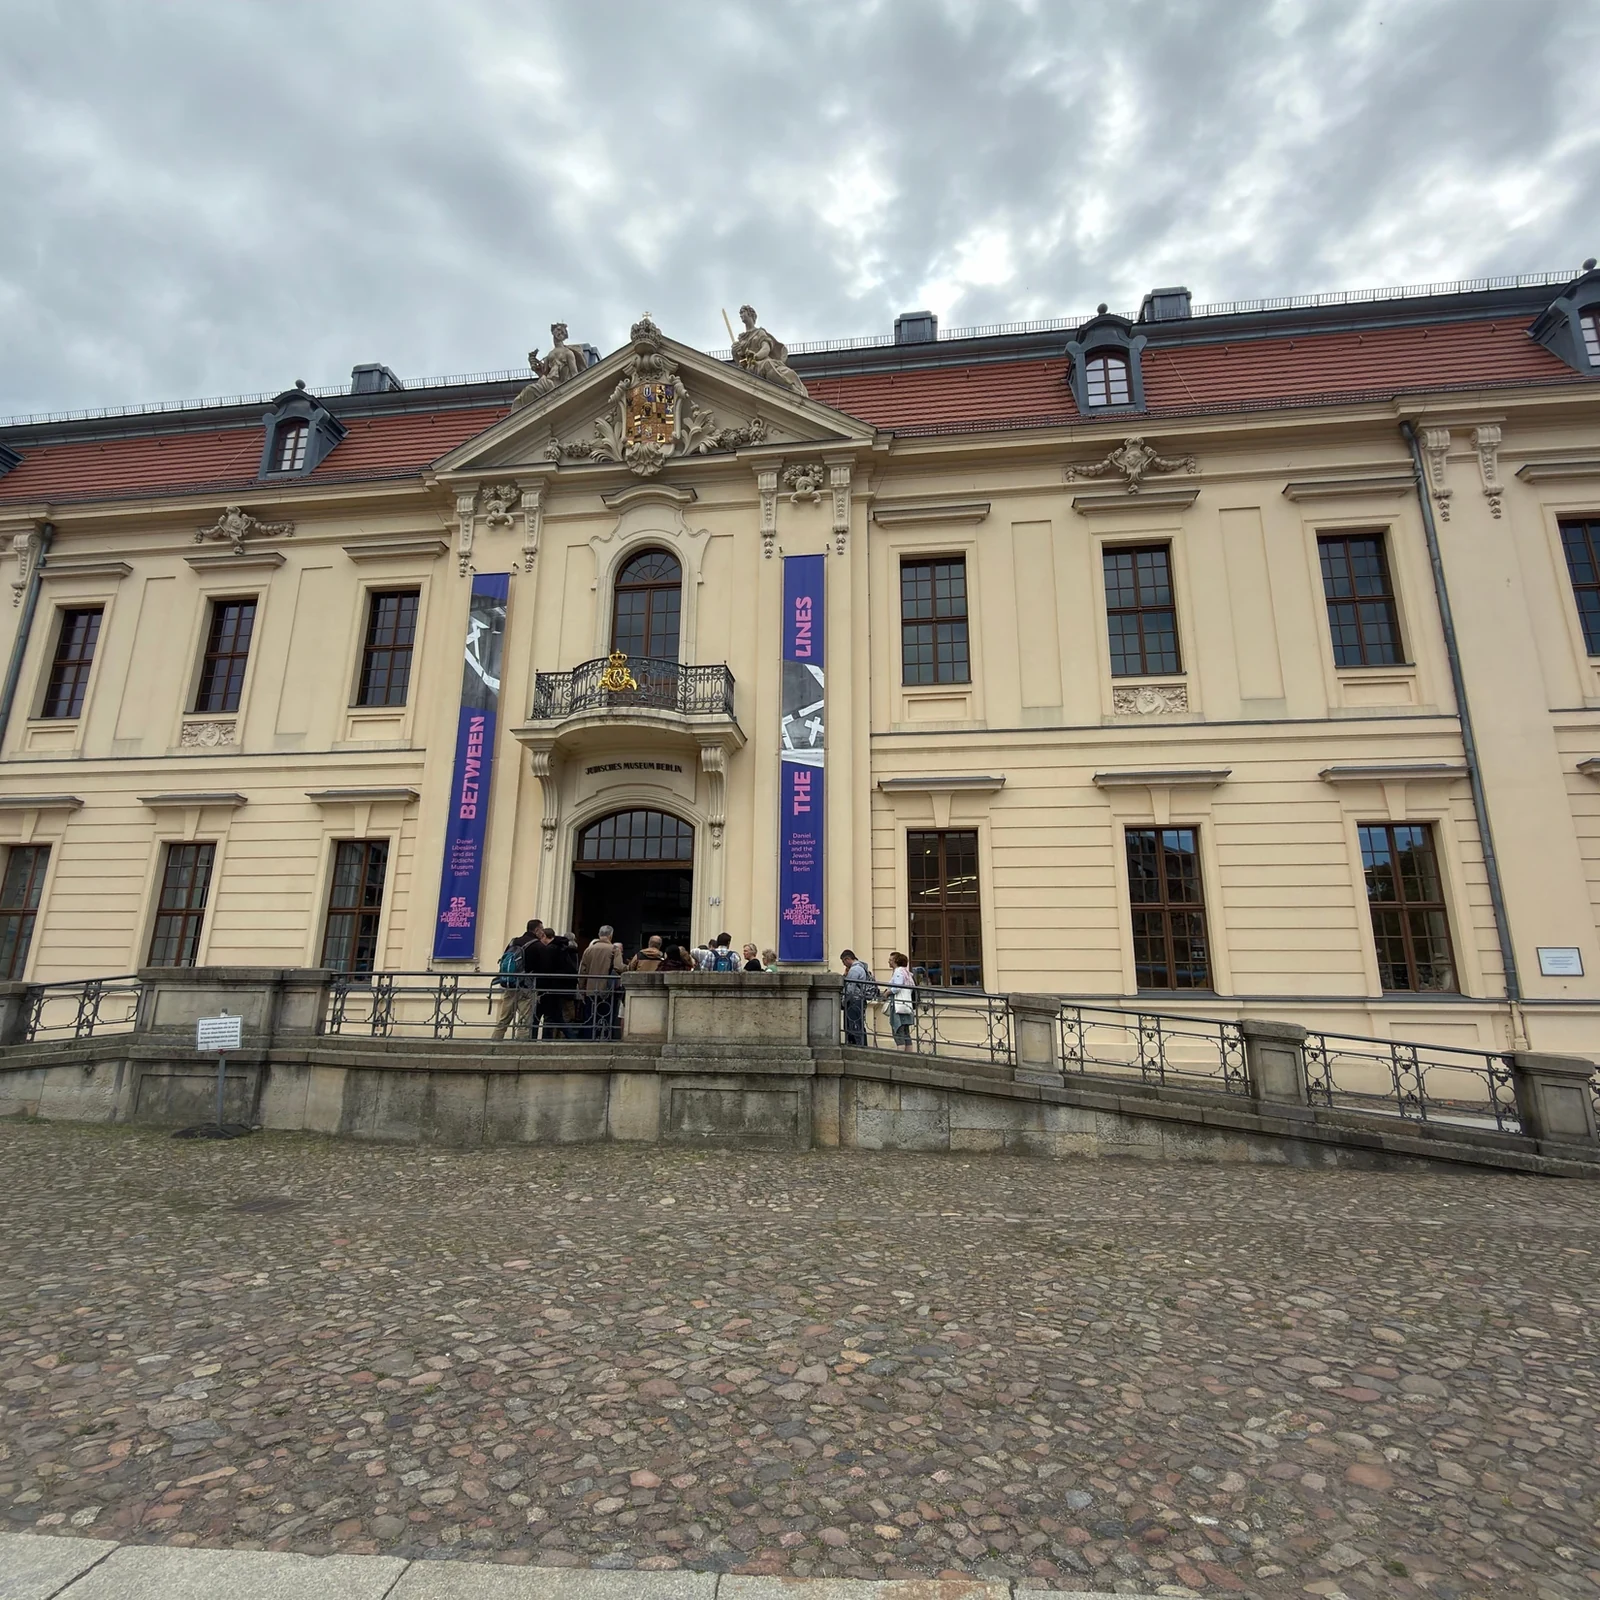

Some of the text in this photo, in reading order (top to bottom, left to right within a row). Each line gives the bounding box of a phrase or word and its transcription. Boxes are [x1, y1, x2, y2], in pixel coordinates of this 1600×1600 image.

[795, 596, 812, 657] LINES
[459, 716, 485, 819] BETWEEN
[623, 762, 655, 770] MUSEUM
[656, 763, 682, 773] BERLIN
[793, 771, 811, 816] THE
[450, 896, 466, 908] 25
[791, 893, 810, 905] 25
